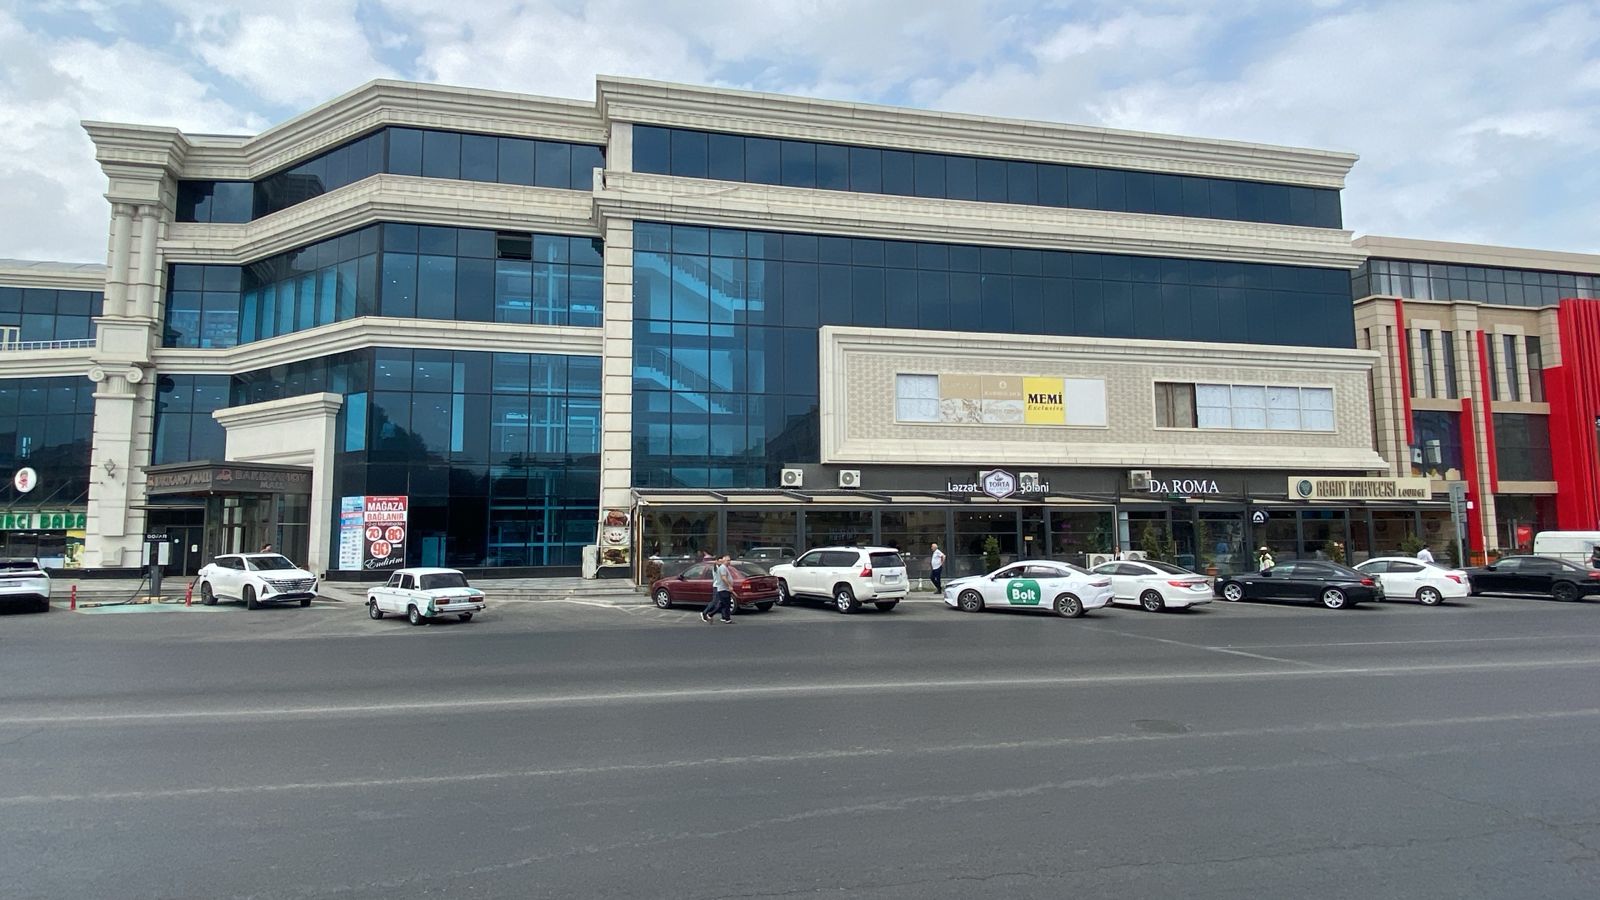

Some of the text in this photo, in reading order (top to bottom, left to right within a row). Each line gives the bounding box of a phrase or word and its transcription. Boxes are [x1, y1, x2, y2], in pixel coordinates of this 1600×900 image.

[1028, 392, 1063, 404] MEMİ
[1020, 482, 1049, 494] Şöləni
[1172, 480, 1219, 493] ROMA
[1398, 489, 1425, 497] LOUNGE
[367, 501, 404, 511] MAĞAZA
[40, 513, 87, 529] BABA
[367, 512, 404, 521] BAĞLANIR
[364, 557, 403, 569] Endirim
[1011, 588, 1036, 601] Bolt
